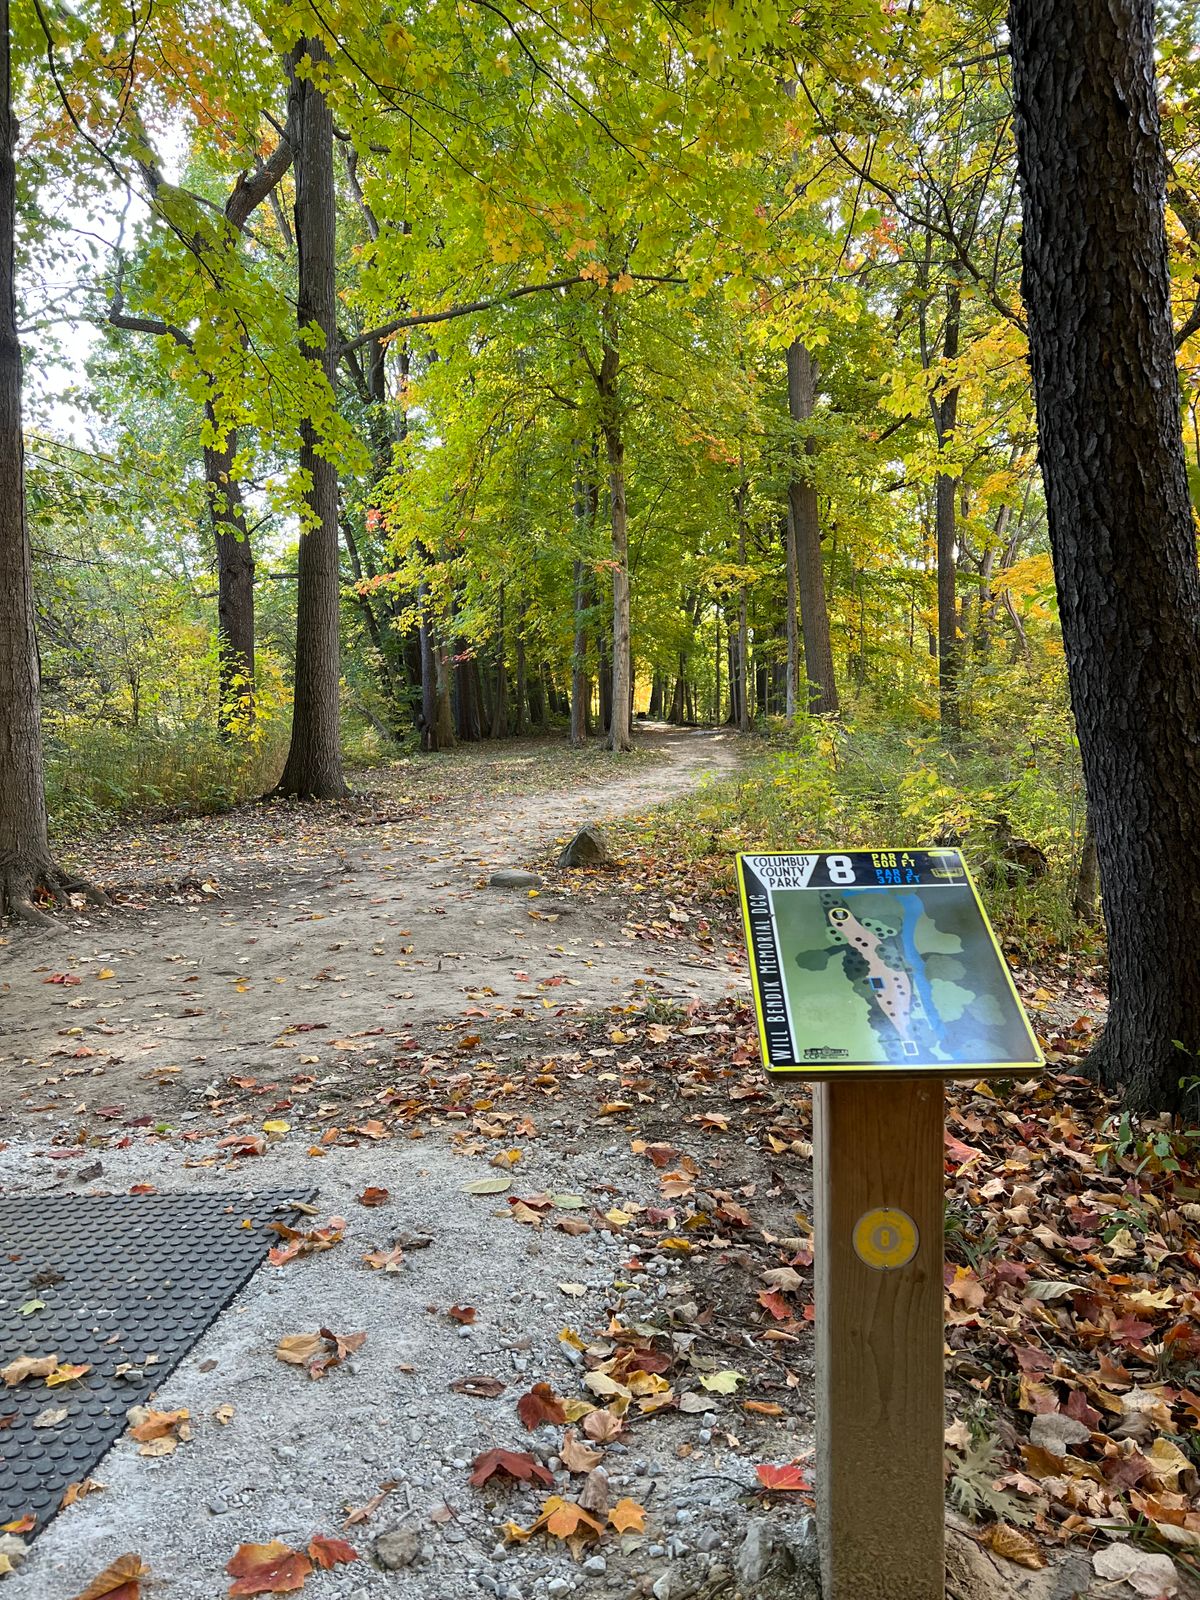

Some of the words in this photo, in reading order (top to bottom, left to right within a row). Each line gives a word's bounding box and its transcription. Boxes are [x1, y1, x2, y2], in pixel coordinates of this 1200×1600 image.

[753, 856, 810, 867] COLUMBUS
[872, 853, 897, 861] PAR
[873, 860, 897, 868] 600
[901, 859, 915, 867] FT
[760, 866, 805, 877] COUNTY
[825, 855, 856, 884] 8
[876, 868, 900, 877] PAR
[905, 868, 914, 876] 3
[769, 876, 802, 888] PARK
[878, 875, 902, 884] 370
[906, 875, 920, 883] FT
[755, 920, 778, 974] MEMORIAL
[763, 981, 786, 1023] BENDIK
[771, 1030, 792, 1061] WILL
